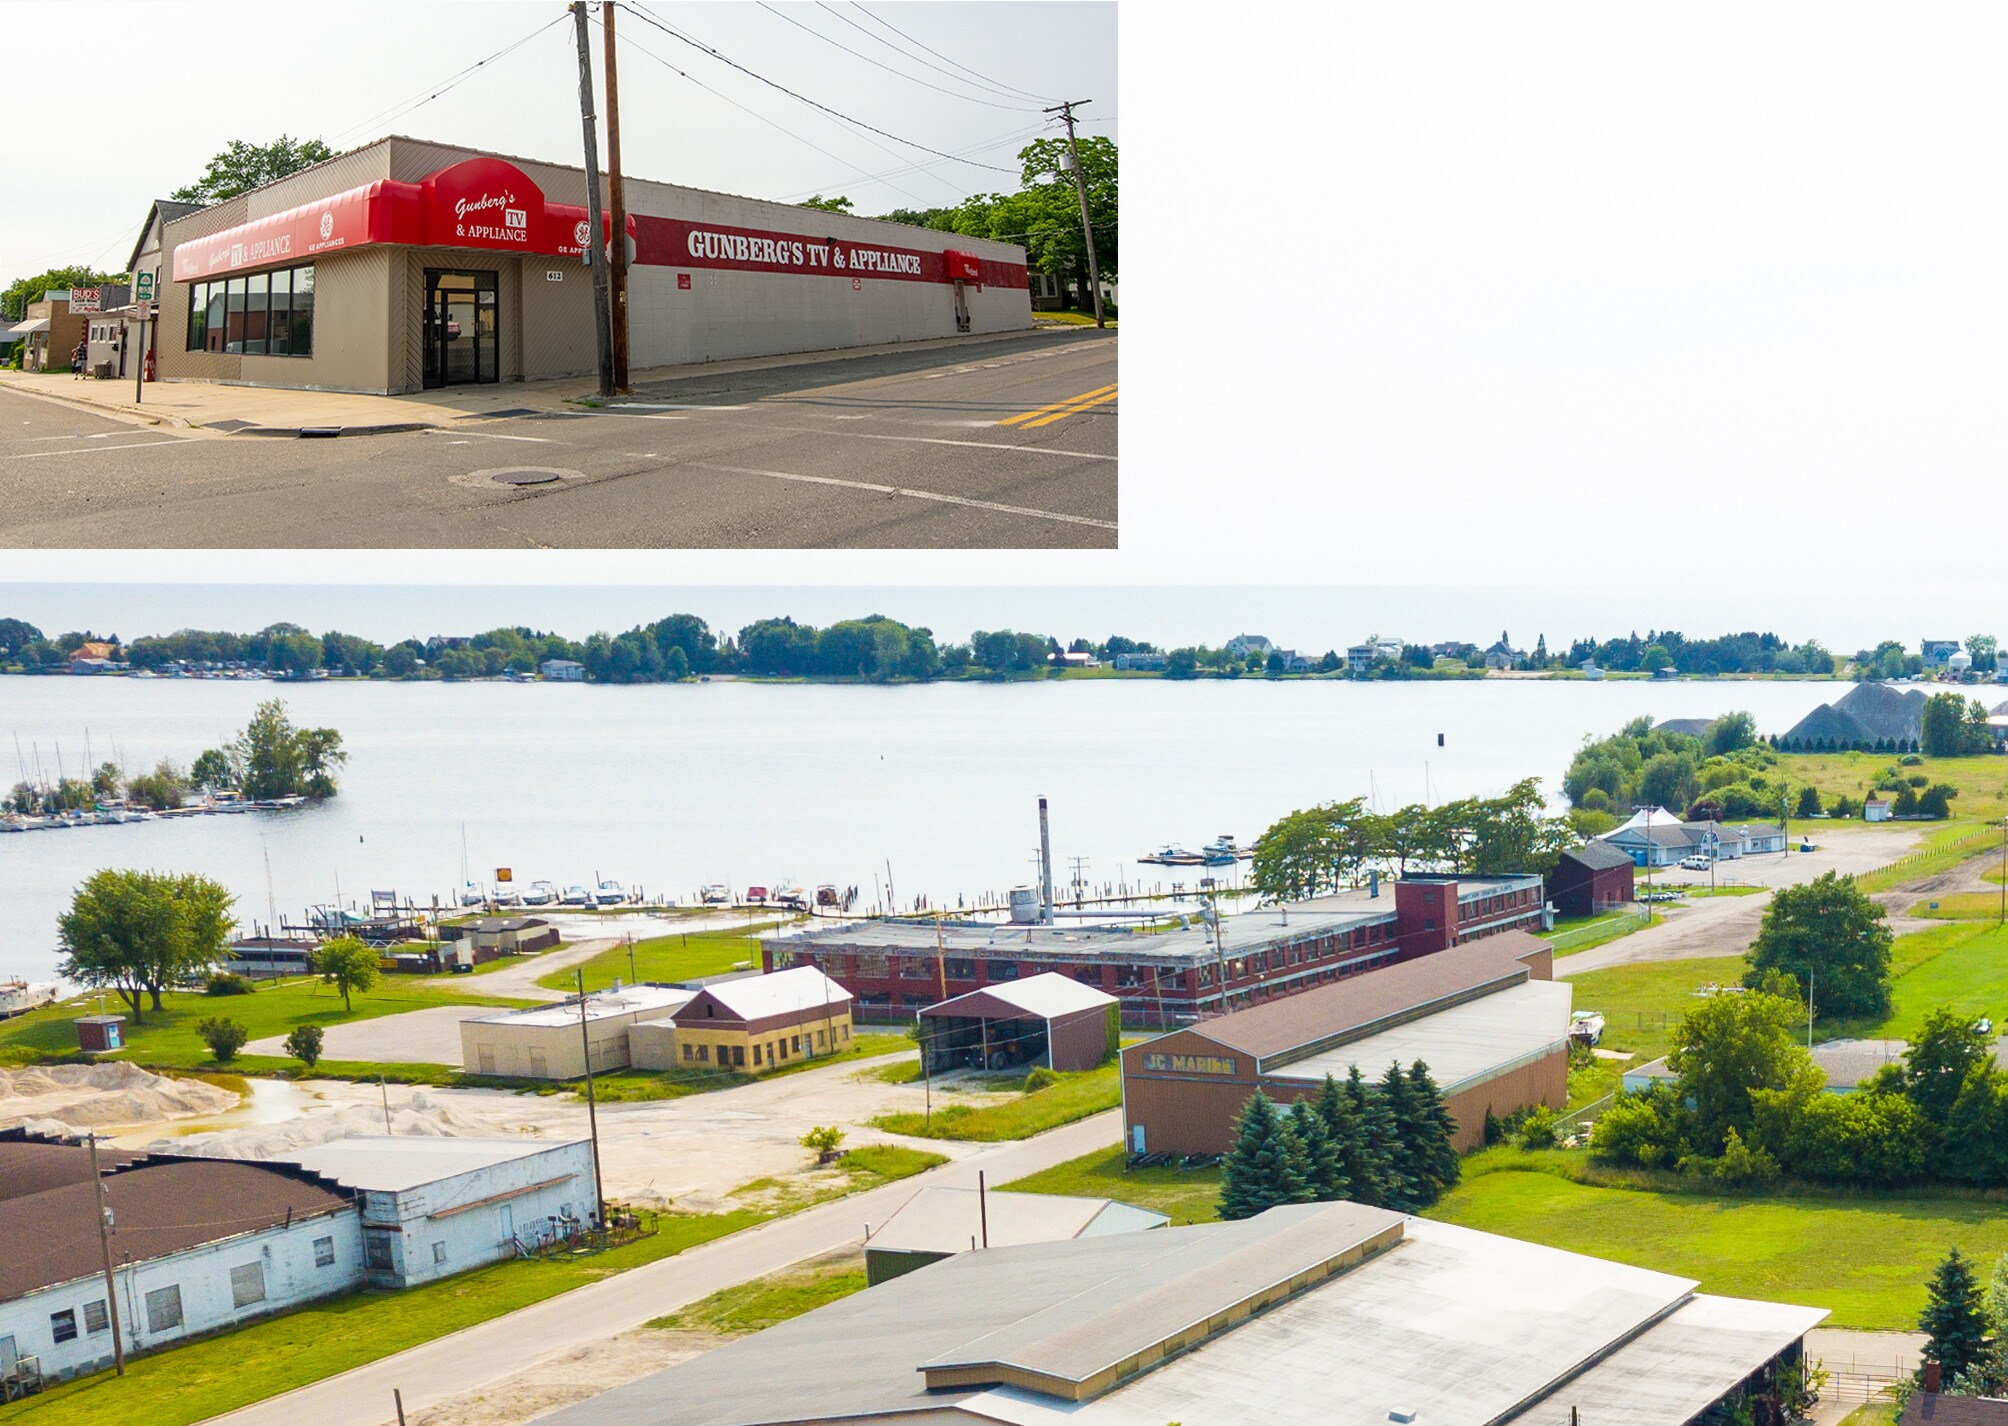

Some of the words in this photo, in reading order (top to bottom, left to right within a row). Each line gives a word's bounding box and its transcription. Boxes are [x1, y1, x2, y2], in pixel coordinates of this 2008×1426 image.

[455, 189, 516, 220] Gunberg's
[507, 211, 525, 227] TV
[456, 224, 465, 237] &
[468, 225, 527, 242] APPLIANCE
[249, 234, 291, 262] APPLIANCE
[318, 237, 345, 249] APPLIANCES
[687, 230, 804, 266] GUNBERG'S
[806, 244, 830, 268] TV
[833, 246, 846, 269] &
[849, 249, 921, 275] APPLIANCE
[548, 272, 562, 280] 612
[73, 289, 100, 300] BUD'S
